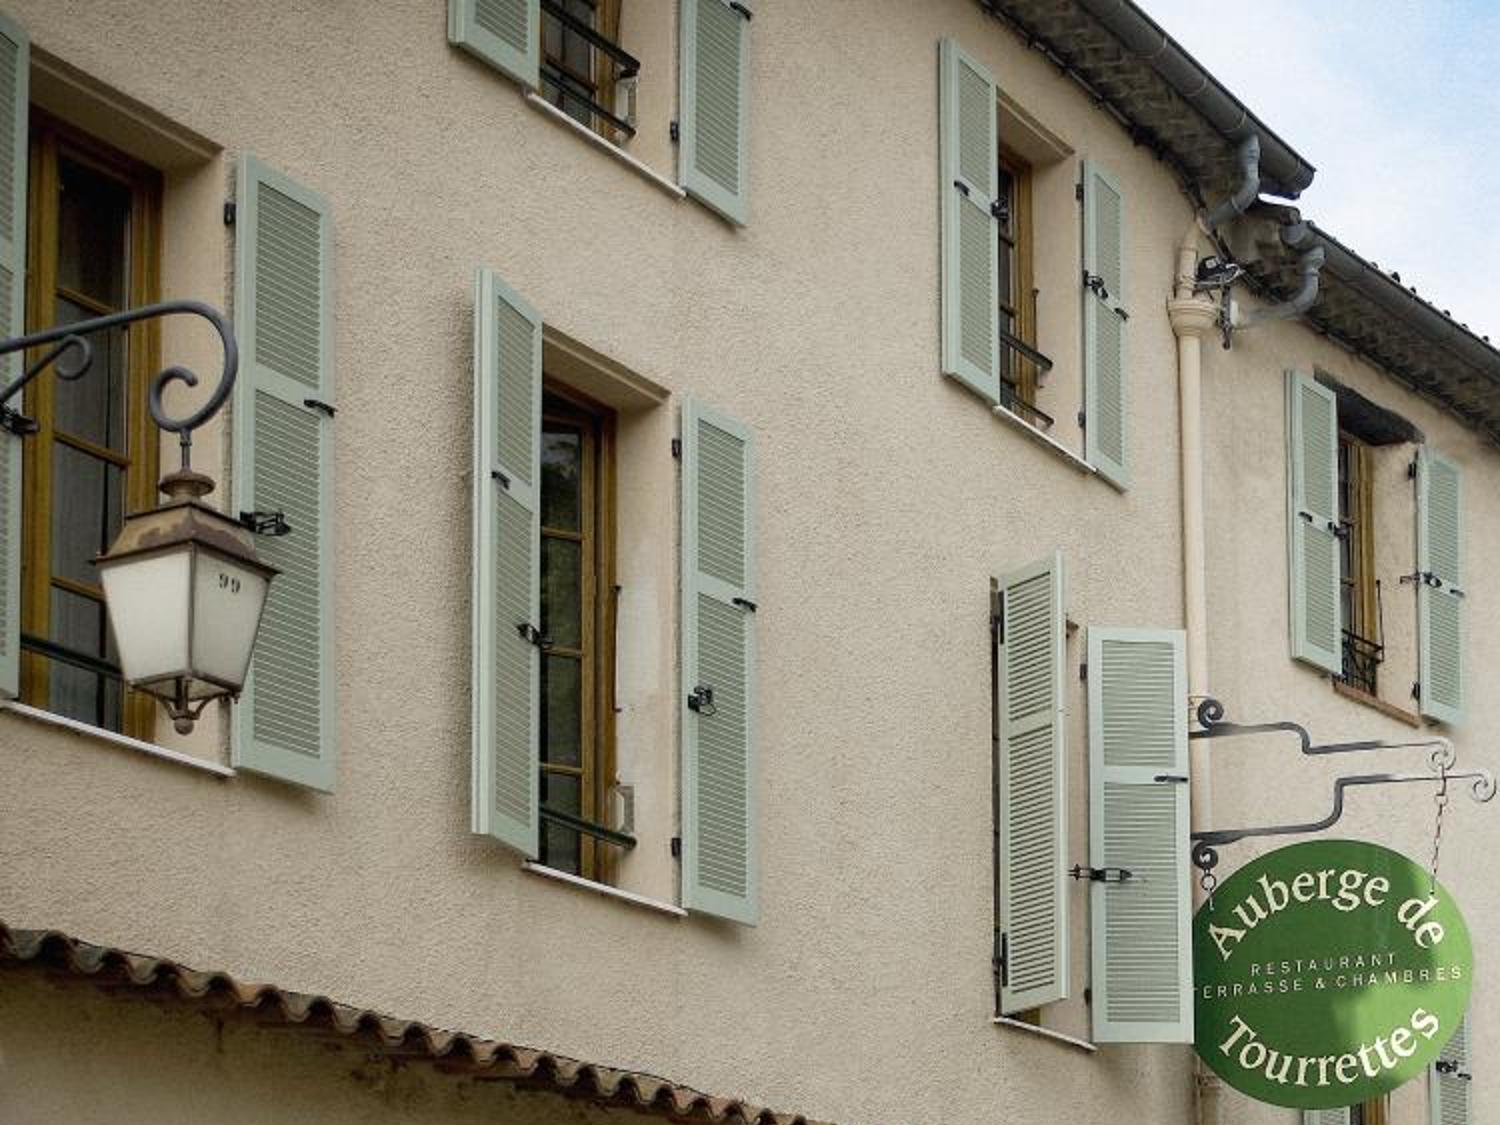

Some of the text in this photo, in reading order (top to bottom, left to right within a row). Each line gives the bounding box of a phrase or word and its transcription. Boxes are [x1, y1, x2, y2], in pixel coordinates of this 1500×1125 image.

[1208, 868, 1445, 961] Auberge de
[1193, 966, 1462, 999] ERRASSE & CHAMBRES
[1251, 953, 1396, 977] RESTAURANT
[1219, 1007, 1440, 1087] Tourrettes
